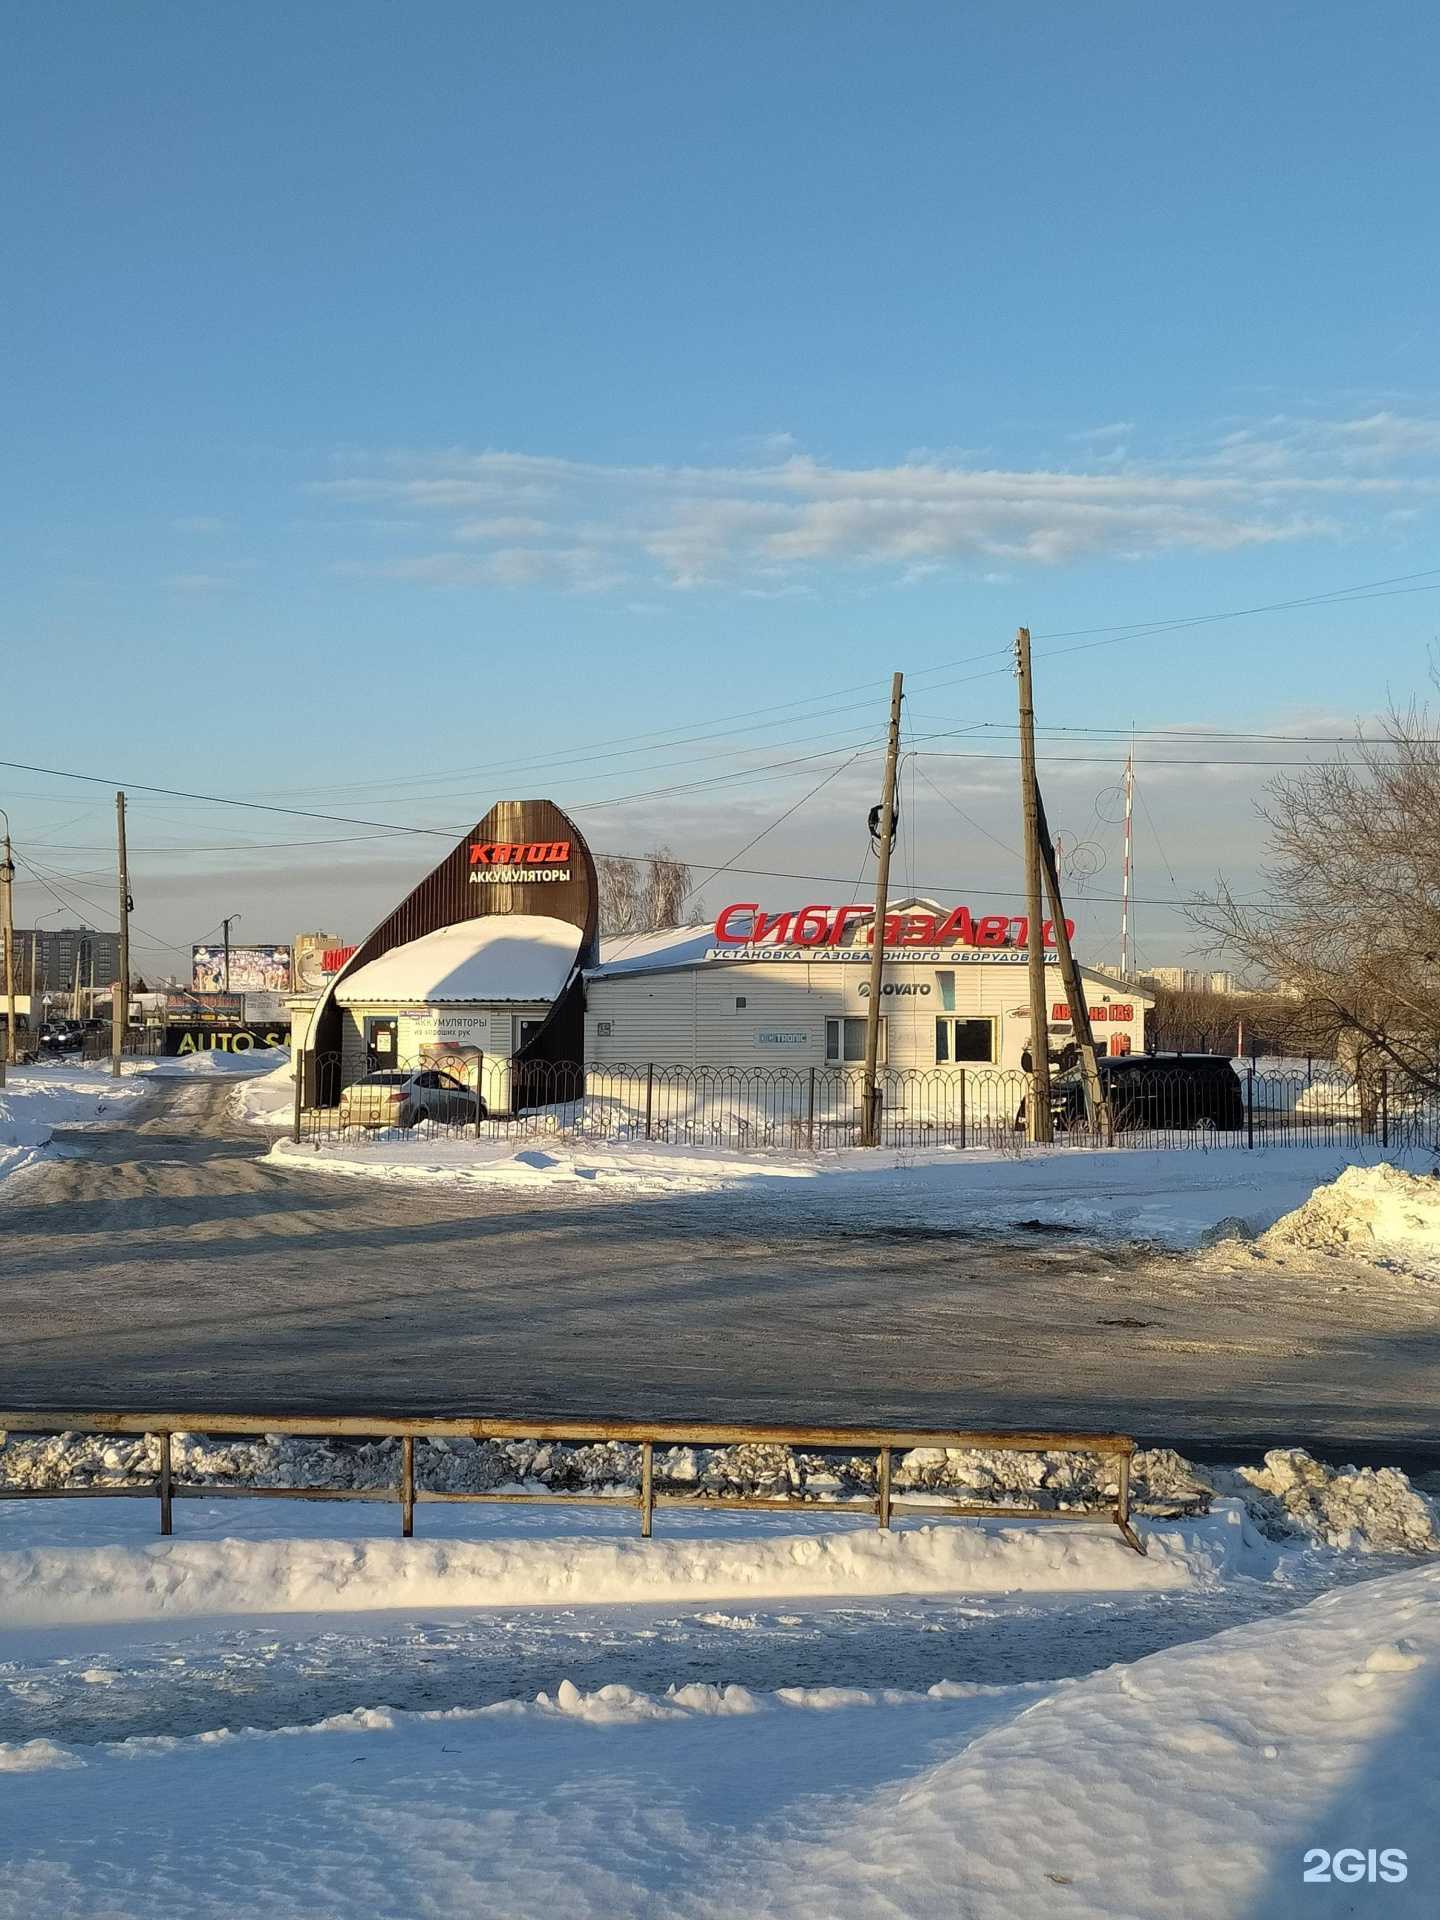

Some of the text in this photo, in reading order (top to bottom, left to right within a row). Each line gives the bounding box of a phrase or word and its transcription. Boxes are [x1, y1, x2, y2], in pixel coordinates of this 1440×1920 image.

[469, 842, 570, 864] КАТОД
[469, 869, 571, 883] АККУМУЛЯТОРЫ
[712, 951, 802, 960] УСТАНОВКА
[879, 983, 931, 996] OVATO
[1109, 1004, 1134, 1022] ГАЗ
[458, 1029, 471, 1037] рук
[176, 1033, 255, 1055] AUTO
